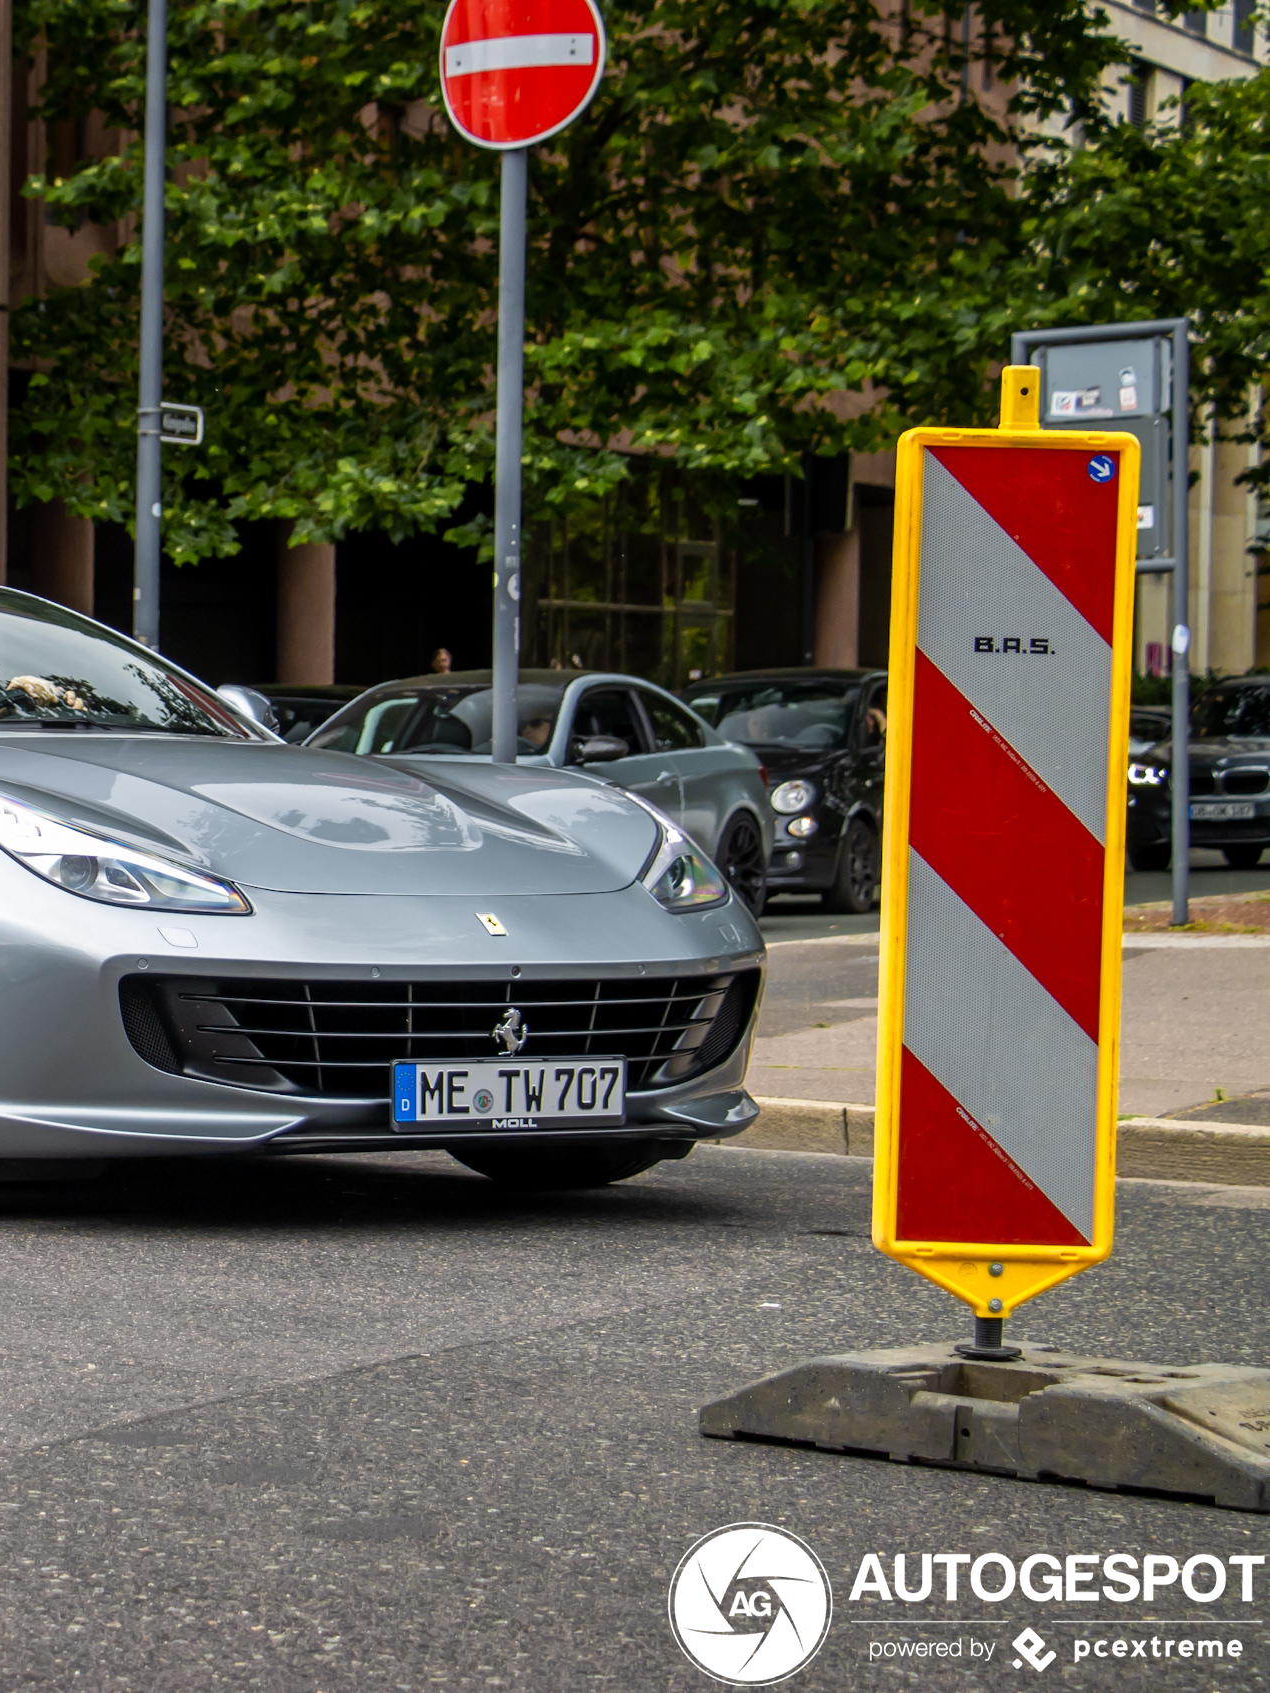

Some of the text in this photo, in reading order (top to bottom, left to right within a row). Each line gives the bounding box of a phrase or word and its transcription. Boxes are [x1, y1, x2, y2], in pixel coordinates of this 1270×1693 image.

[974, 636, 1056, 655] B.A.S.
[401, 1098, 410, 1112] D
[420, 1070, 470, 1115] ME
[498, 1067, 546, 1113] TW
[555, 1066, 620, 1111] 707
[492, 1118, 538, 1129] MOLL
